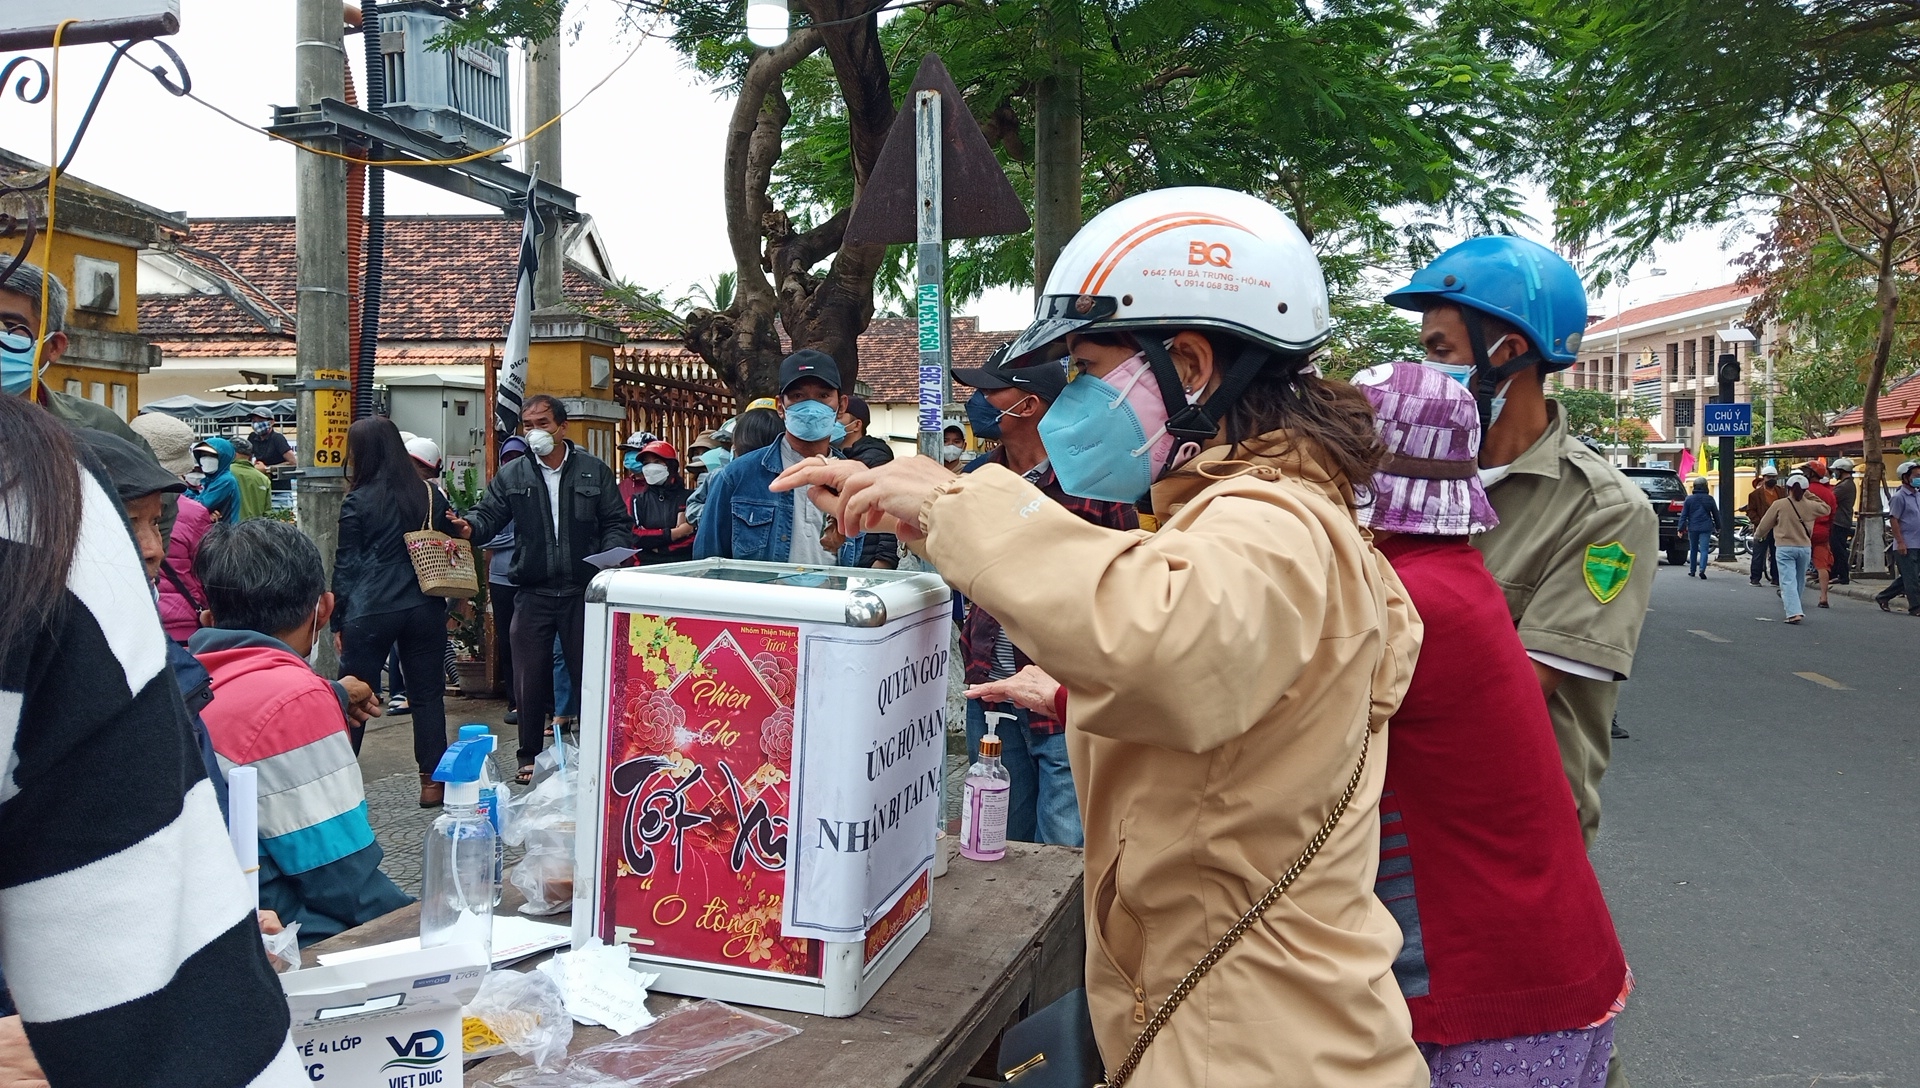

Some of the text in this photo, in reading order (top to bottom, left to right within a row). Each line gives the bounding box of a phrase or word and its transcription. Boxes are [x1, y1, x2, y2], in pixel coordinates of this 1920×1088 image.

[1188, 241, 1233, 268] BQ
[1150, 269, 1167, 277] 642
[1187, 268, 1200, 278] BÀ
[1241, 276, 1257, 286] HỘI
[1258, 280, 1271, 288] AN
[1184, 279, 1240, 292] 0914 068 333
[919, 285, 940, 351] 0934.334.734
[1714, 408, 1741, 420] CHÚ Ý
[1706, 420, 1749, 433] QUAN SÁT
[741, 626, 796, 638] Nhóm Thiện Thiện
[760, 636, 788, 653] Tươi
[878, 643, 948, 716] QUYÊN GÓP
[691, 679, 752, 710] Phiên
[700, 719, 741, 749] Chợ
[897, 718, 915, 760] HỘ
[916, 706, 945, 748] NẠN
[815, 803, 888, 853] NHÂN
[887, 791, 901, 830] BỊ
[903, 774, 925, 816] TAI
[319, 1042, 328, 1054] 4
[332, 1035, 362, 1052] LỚP
[386, 1029, 445, 1058] VD
[418, 1069, 443, 1086] DUC
